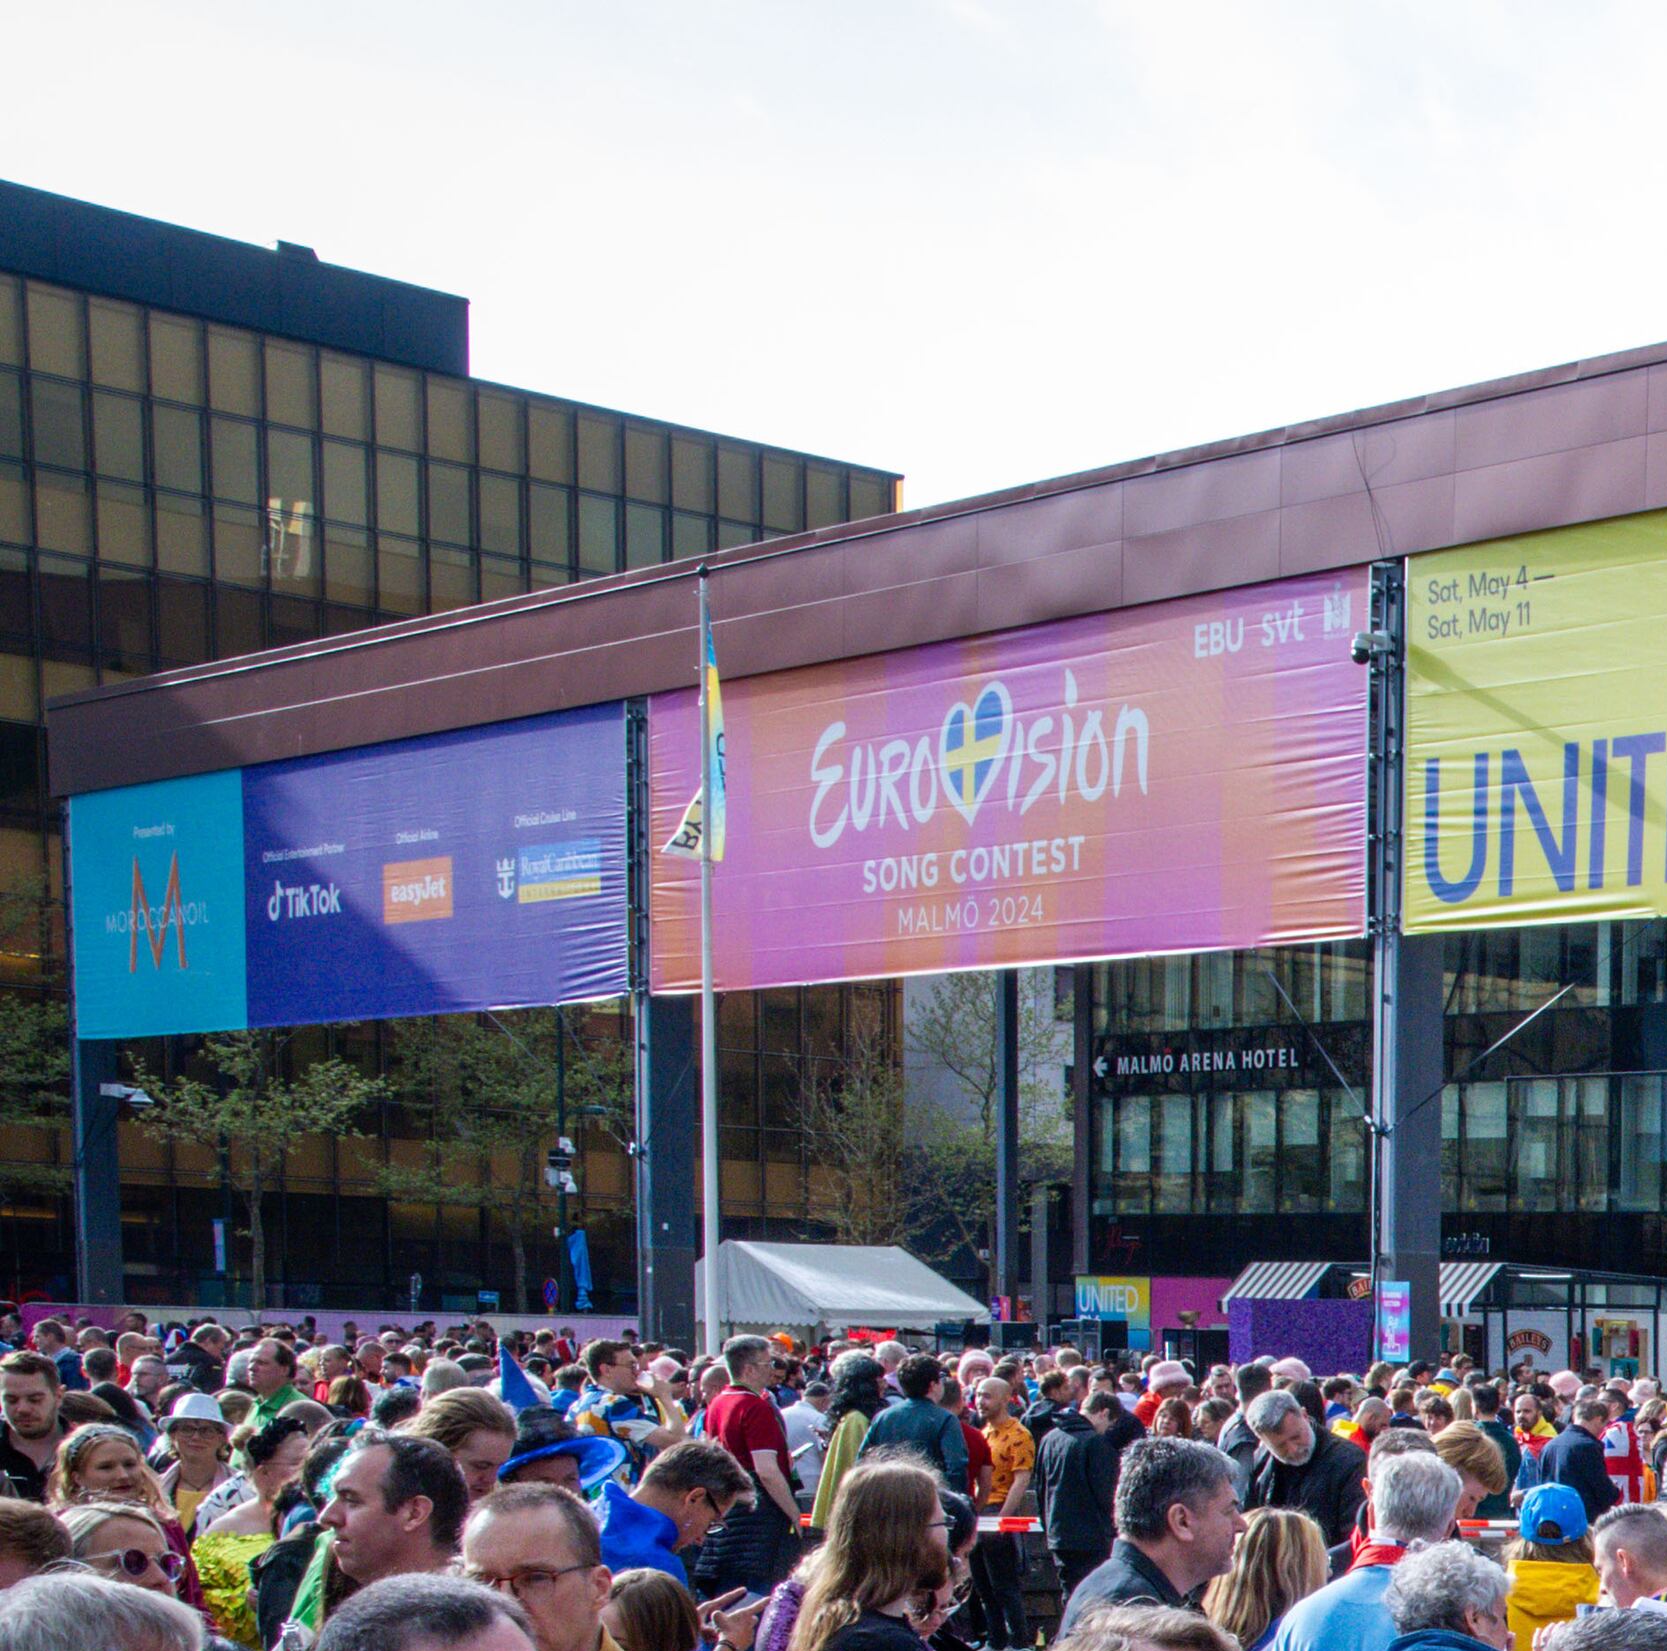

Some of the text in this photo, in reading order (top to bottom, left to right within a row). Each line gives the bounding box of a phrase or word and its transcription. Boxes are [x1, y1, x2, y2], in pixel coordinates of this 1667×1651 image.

[1427, 572, 1465, 604] Sat,
[1467, 569, 1513, 602] May
[1515, 565, 1529, 590] 4
[1194, 599, 1305, 659] EBU svt
[1426, 601, 1532, 641] Sat, May 11
[862, 834, 1085, 894] SONG CONTEST
[285, 882, 342, 919] TikTok
[390, 874, 446, 906] easyJet
[105, 901, 209, 934] MOROCCANOIL
[897, 893, 1044, 935] MALMÖ 2024
[1116, 1048, 1299, 1076] MALMÖ ARENA HOTEL
[1078, 1285, 1139, 1313] UNITED
[1508, 1330, 1550, 1350] BAILEYS
